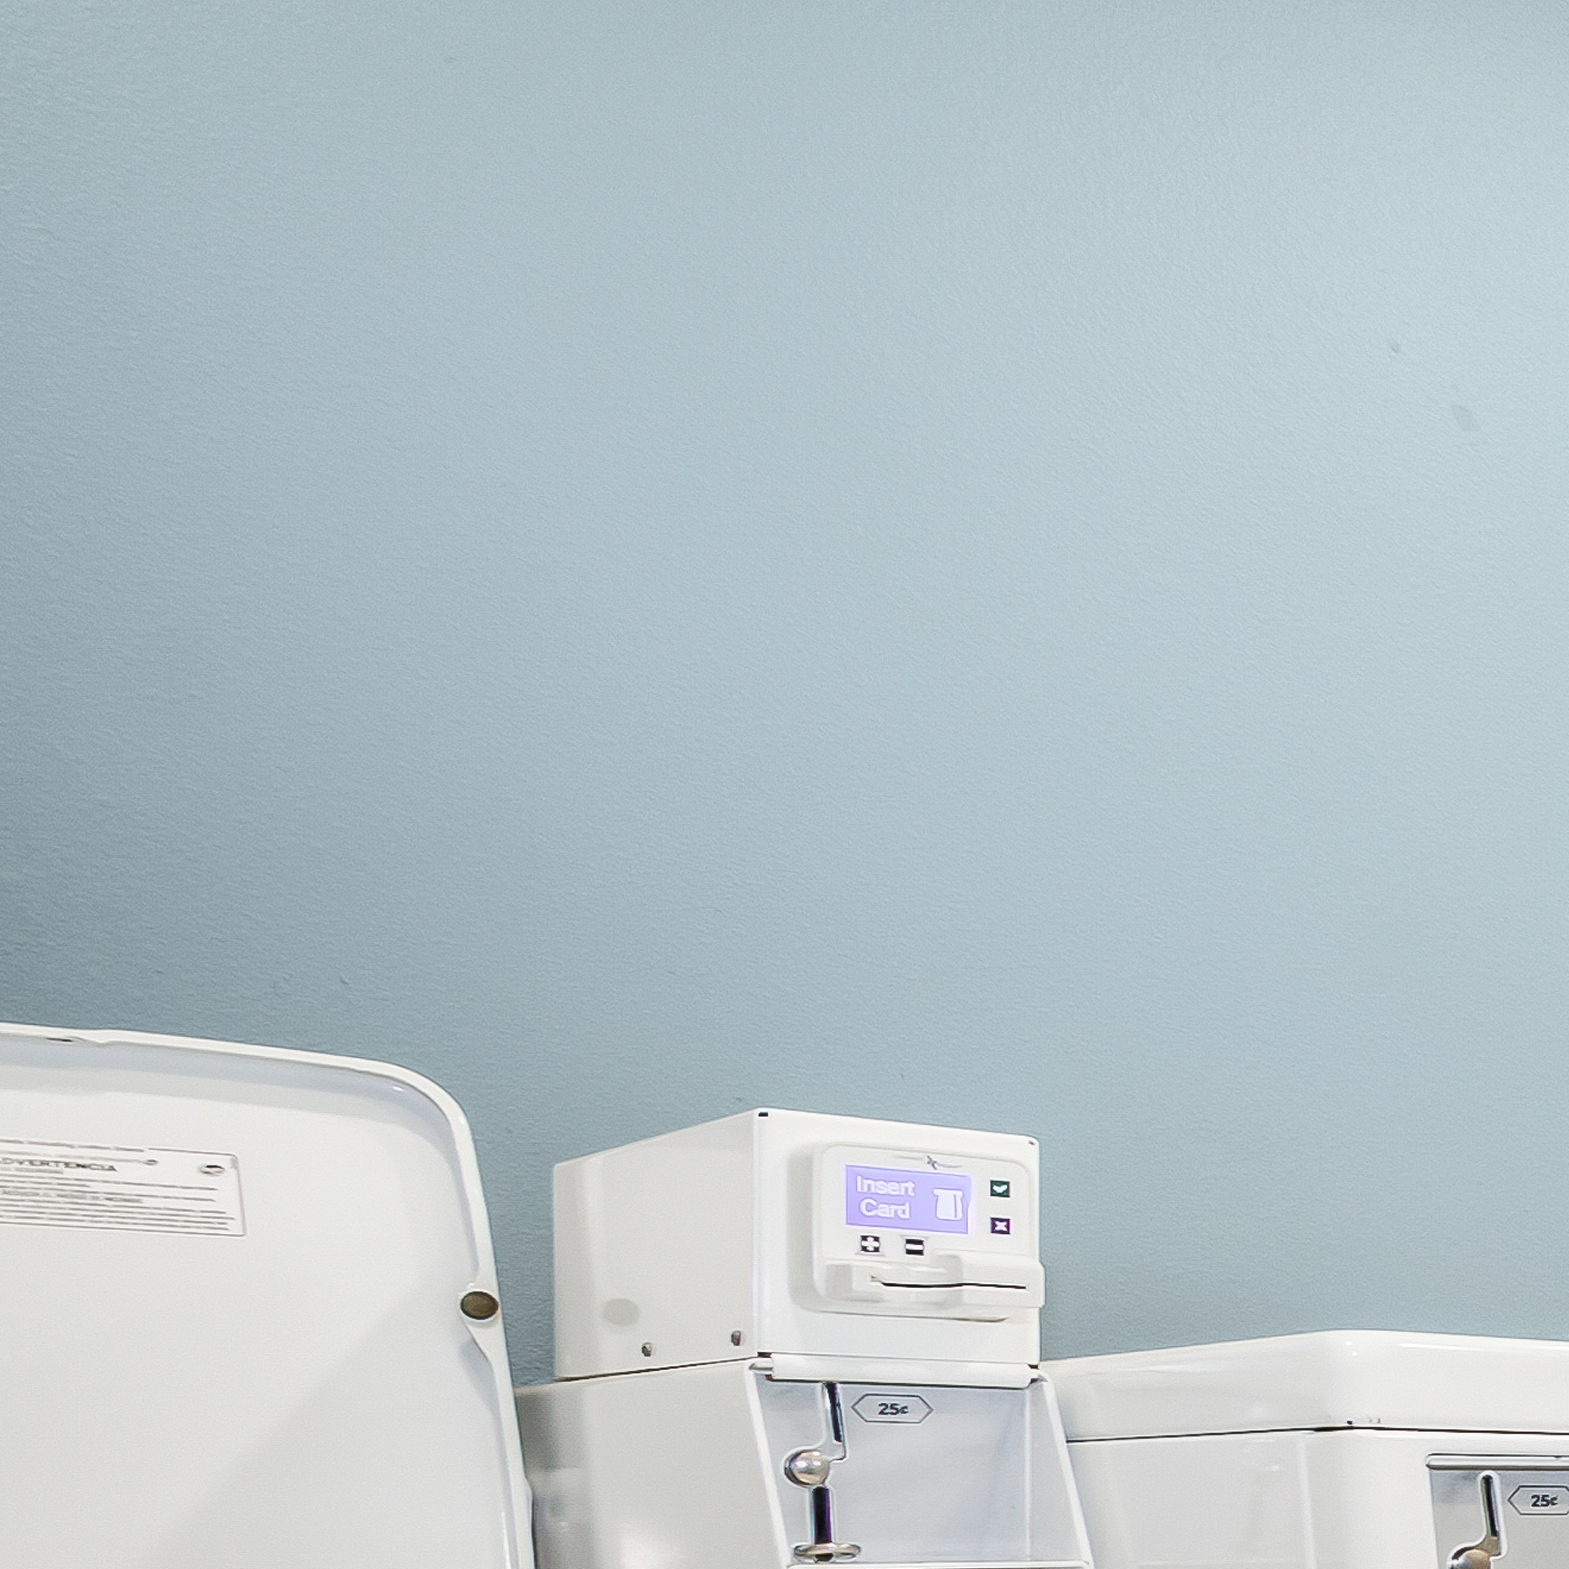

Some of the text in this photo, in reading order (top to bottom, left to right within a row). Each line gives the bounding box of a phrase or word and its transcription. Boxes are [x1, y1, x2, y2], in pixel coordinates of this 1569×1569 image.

[0, 1157, 117, 1172] DVERTENCIA
[856, 1175, 915, 1197] Insert
[860, 1198, 910, 1219] Card
